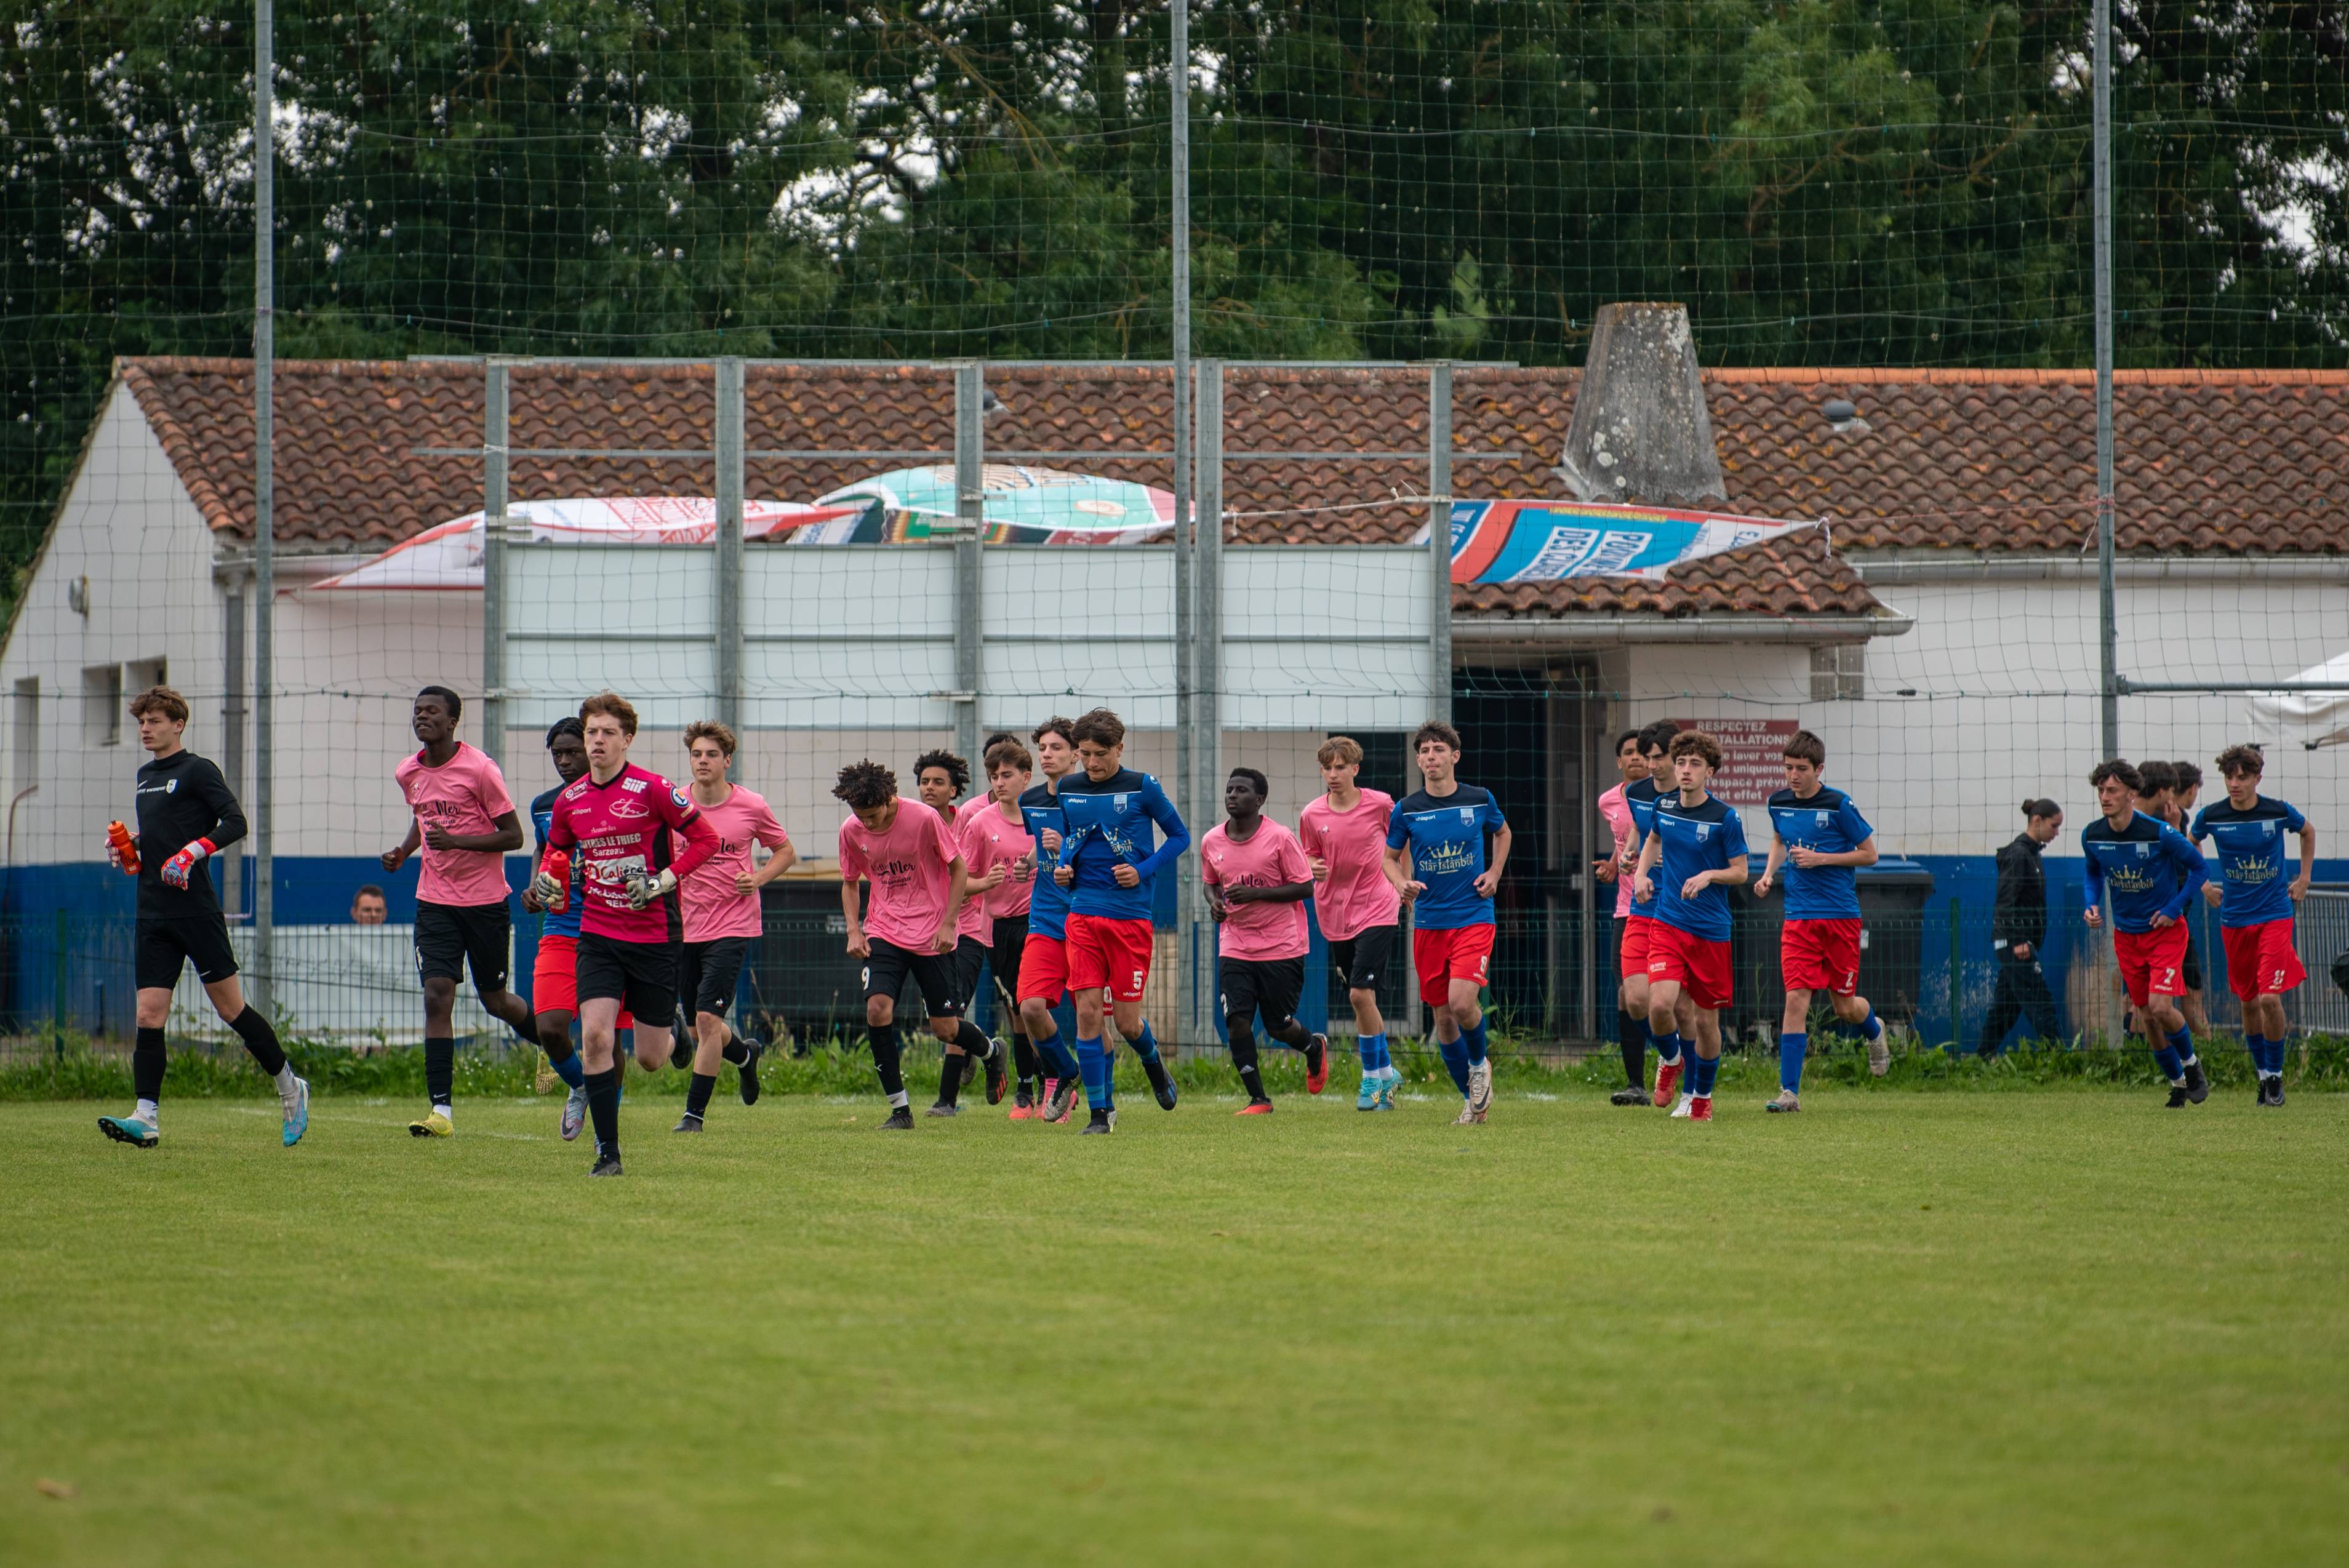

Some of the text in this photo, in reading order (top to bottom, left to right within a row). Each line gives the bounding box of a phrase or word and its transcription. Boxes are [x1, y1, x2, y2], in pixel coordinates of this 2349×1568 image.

[1697, 721, 1767, 732] RESPECTEZ
[1733, 750, 1760, 760] laver
[1764, 752, 1783, 761] vos
[1733, 764, 1785, 776] uniqueme
[1706, 777, 1788, 788] l'espace prévu
[1734, 789, 1763, 800] effet
[606, 836, 616, 846] LE
[615, 833, 641, 846] THIEC
[593, 847, 625, 857] Sarzeau
[889, 860, 916, 875] Mer
[1480, 955, 1487, 972] 8
[862, 966, 870, 990] 9
[1133, 970, 1143, 990] 5
[1846, 972, 1854, 987] 2
